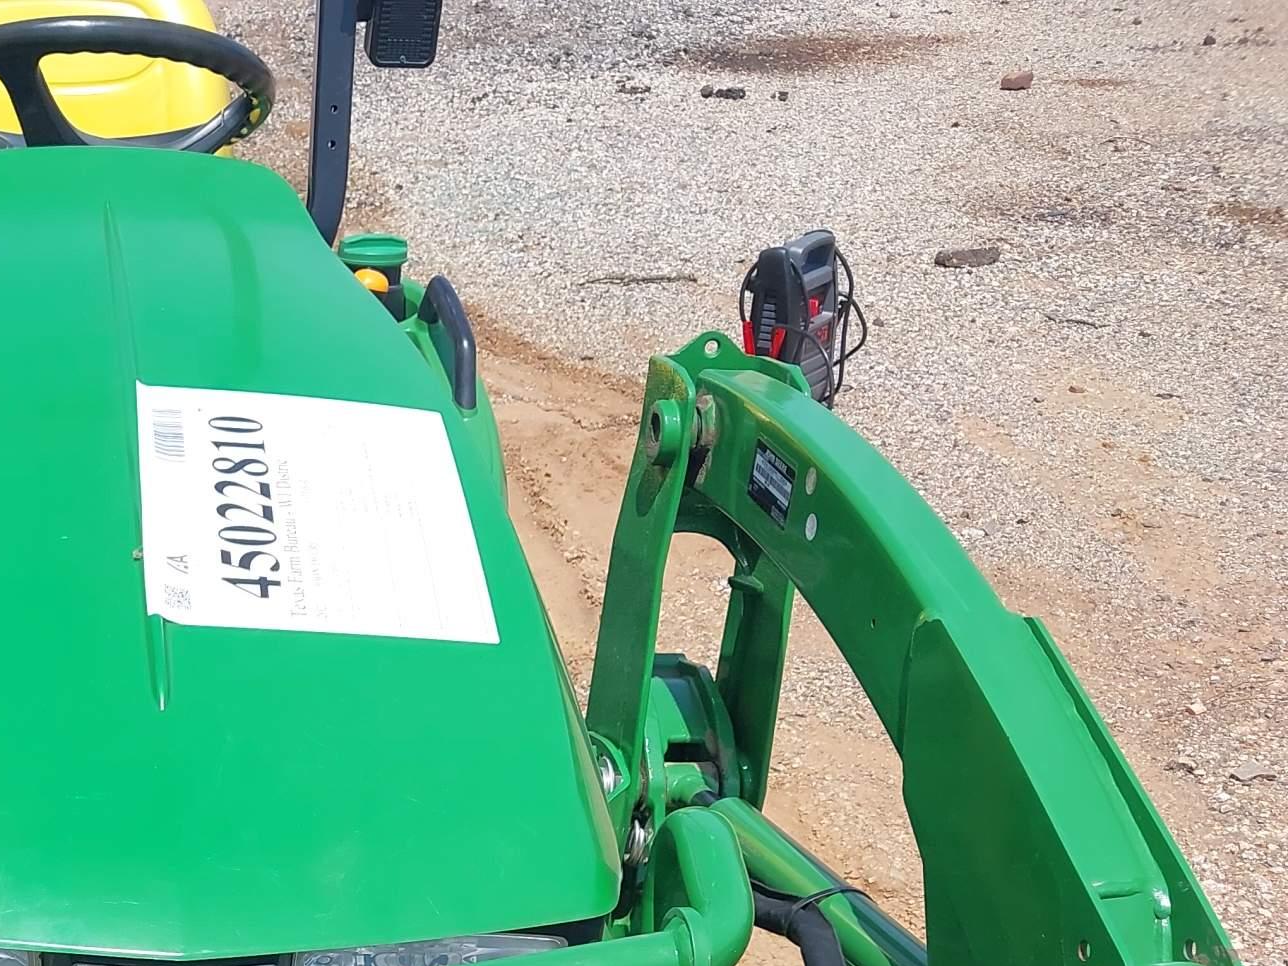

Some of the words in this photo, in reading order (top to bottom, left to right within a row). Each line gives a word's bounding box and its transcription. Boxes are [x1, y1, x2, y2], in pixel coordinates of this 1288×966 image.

[208, 416, 281, 598] 45022810
[283, 518, 300, 552] Bureau
[287, 556, 303, 582] Farm
